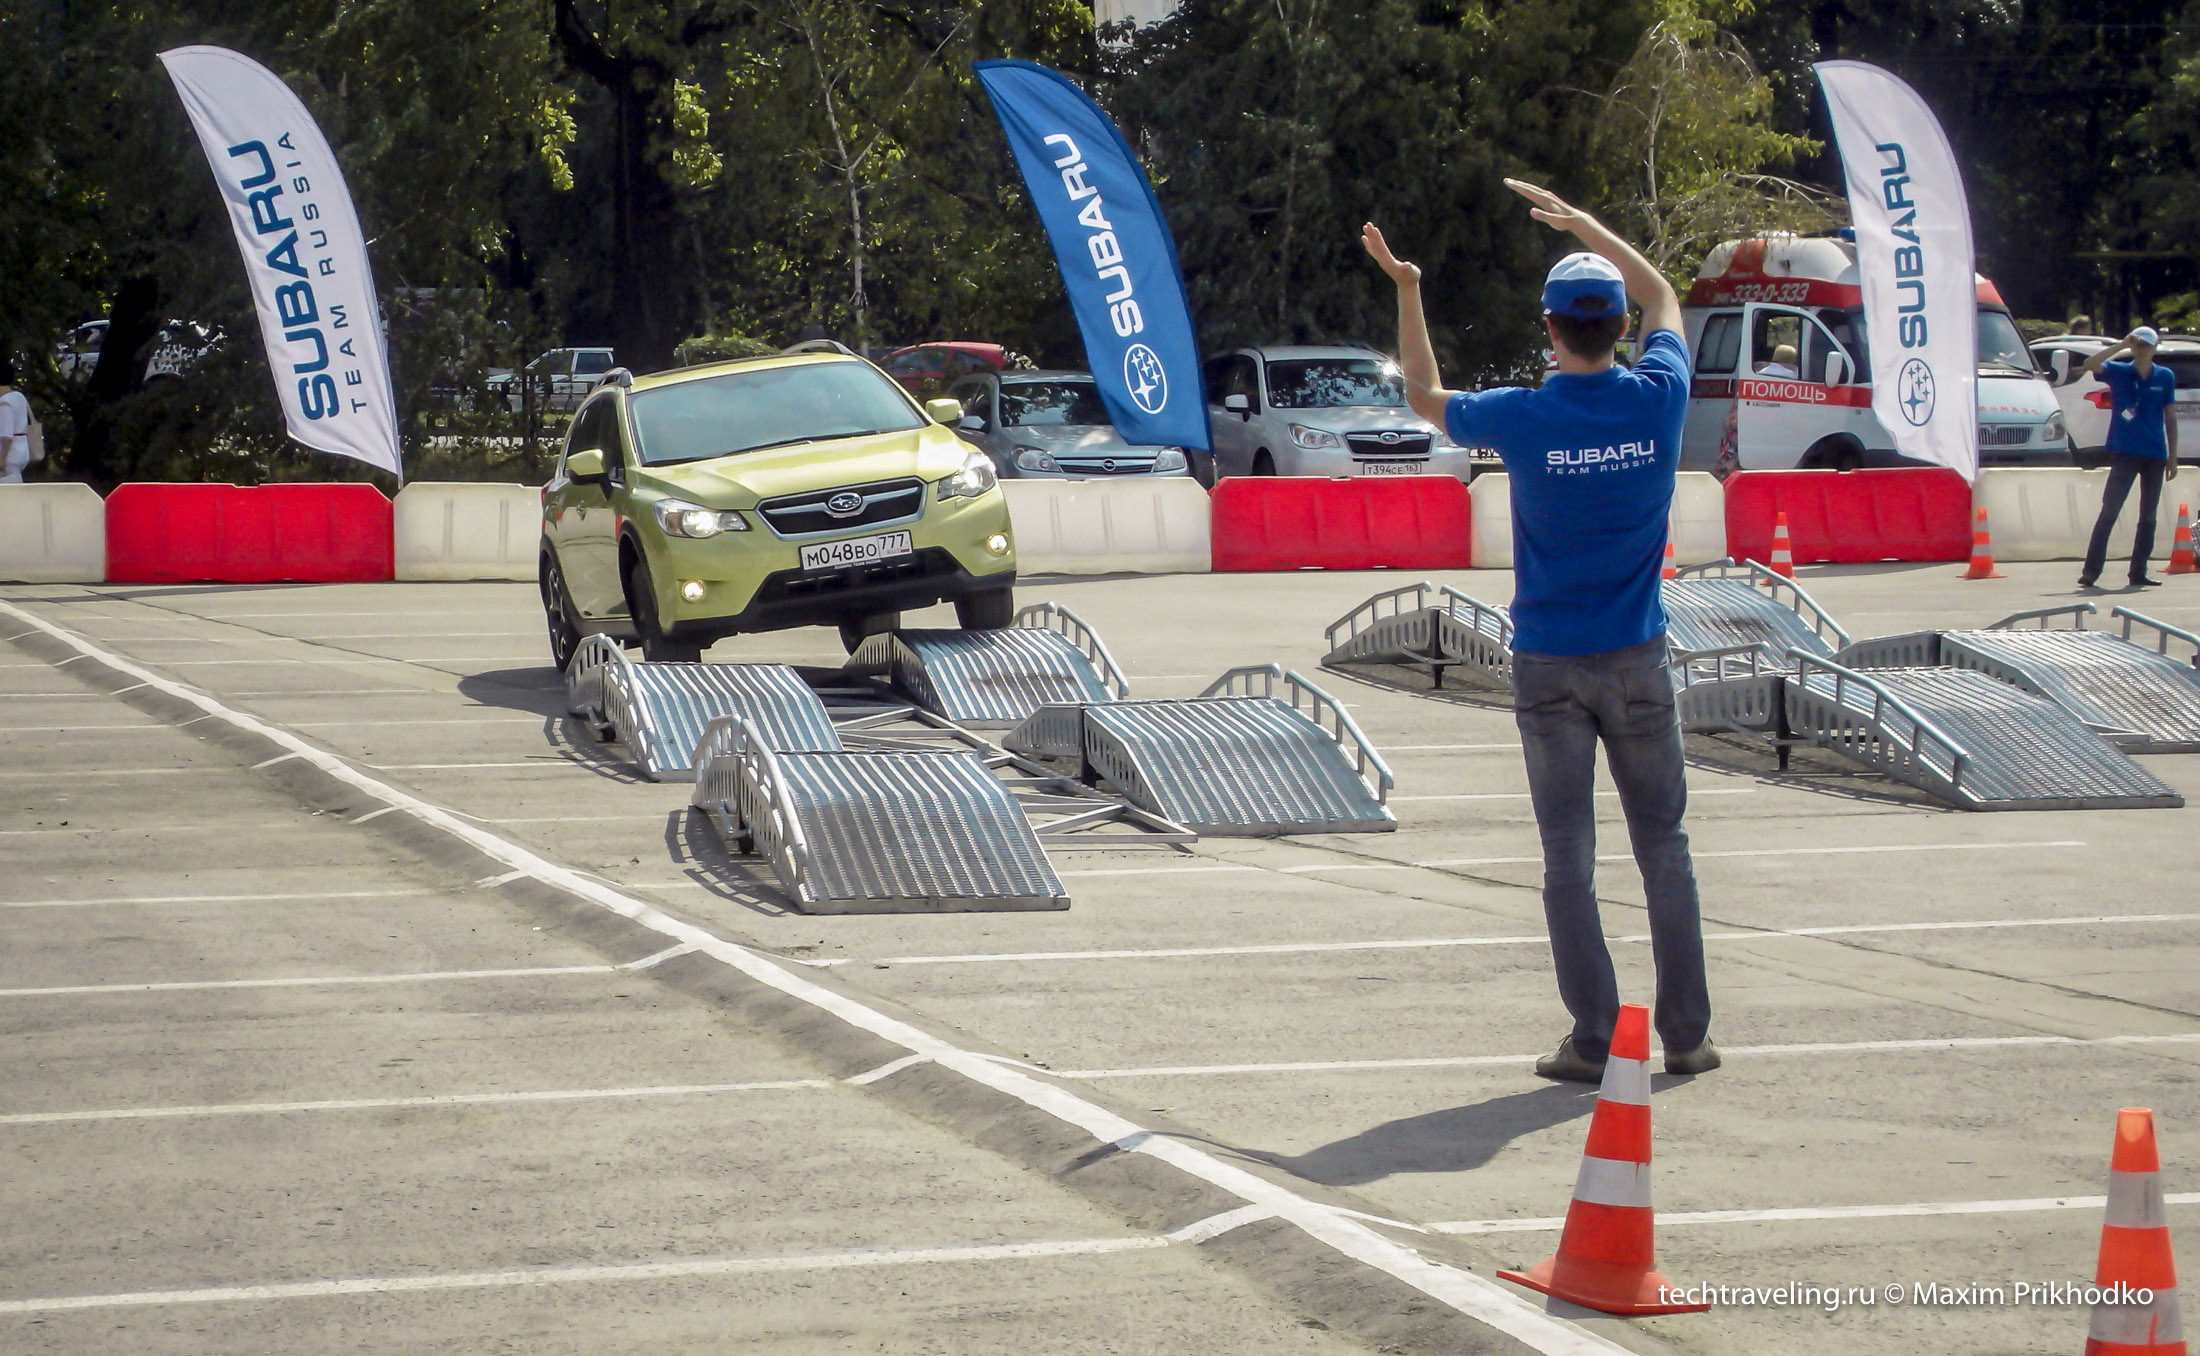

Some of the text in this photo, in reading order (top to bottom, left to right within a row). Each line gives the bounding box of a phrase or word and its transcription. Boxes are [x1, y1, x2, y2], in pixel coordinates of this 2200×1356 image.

[1043, 133, 1144, 338] SUBARU
[1875, 142, 1928, 348] SUBARU
[227, 139, 340, 421] SUBARU
[277, 131, 367, 413] TEAM RUSSIA
[1731, 282, 1810, 303] 333-0-333
[1743, 381, 1827, 404] ПОМОЩЬ
[1546, 439, 1655, 465] SUBARU
[1545, 456, 1656, 475] TEAM RUSSIA
[878, 533, 905, 550] 777
